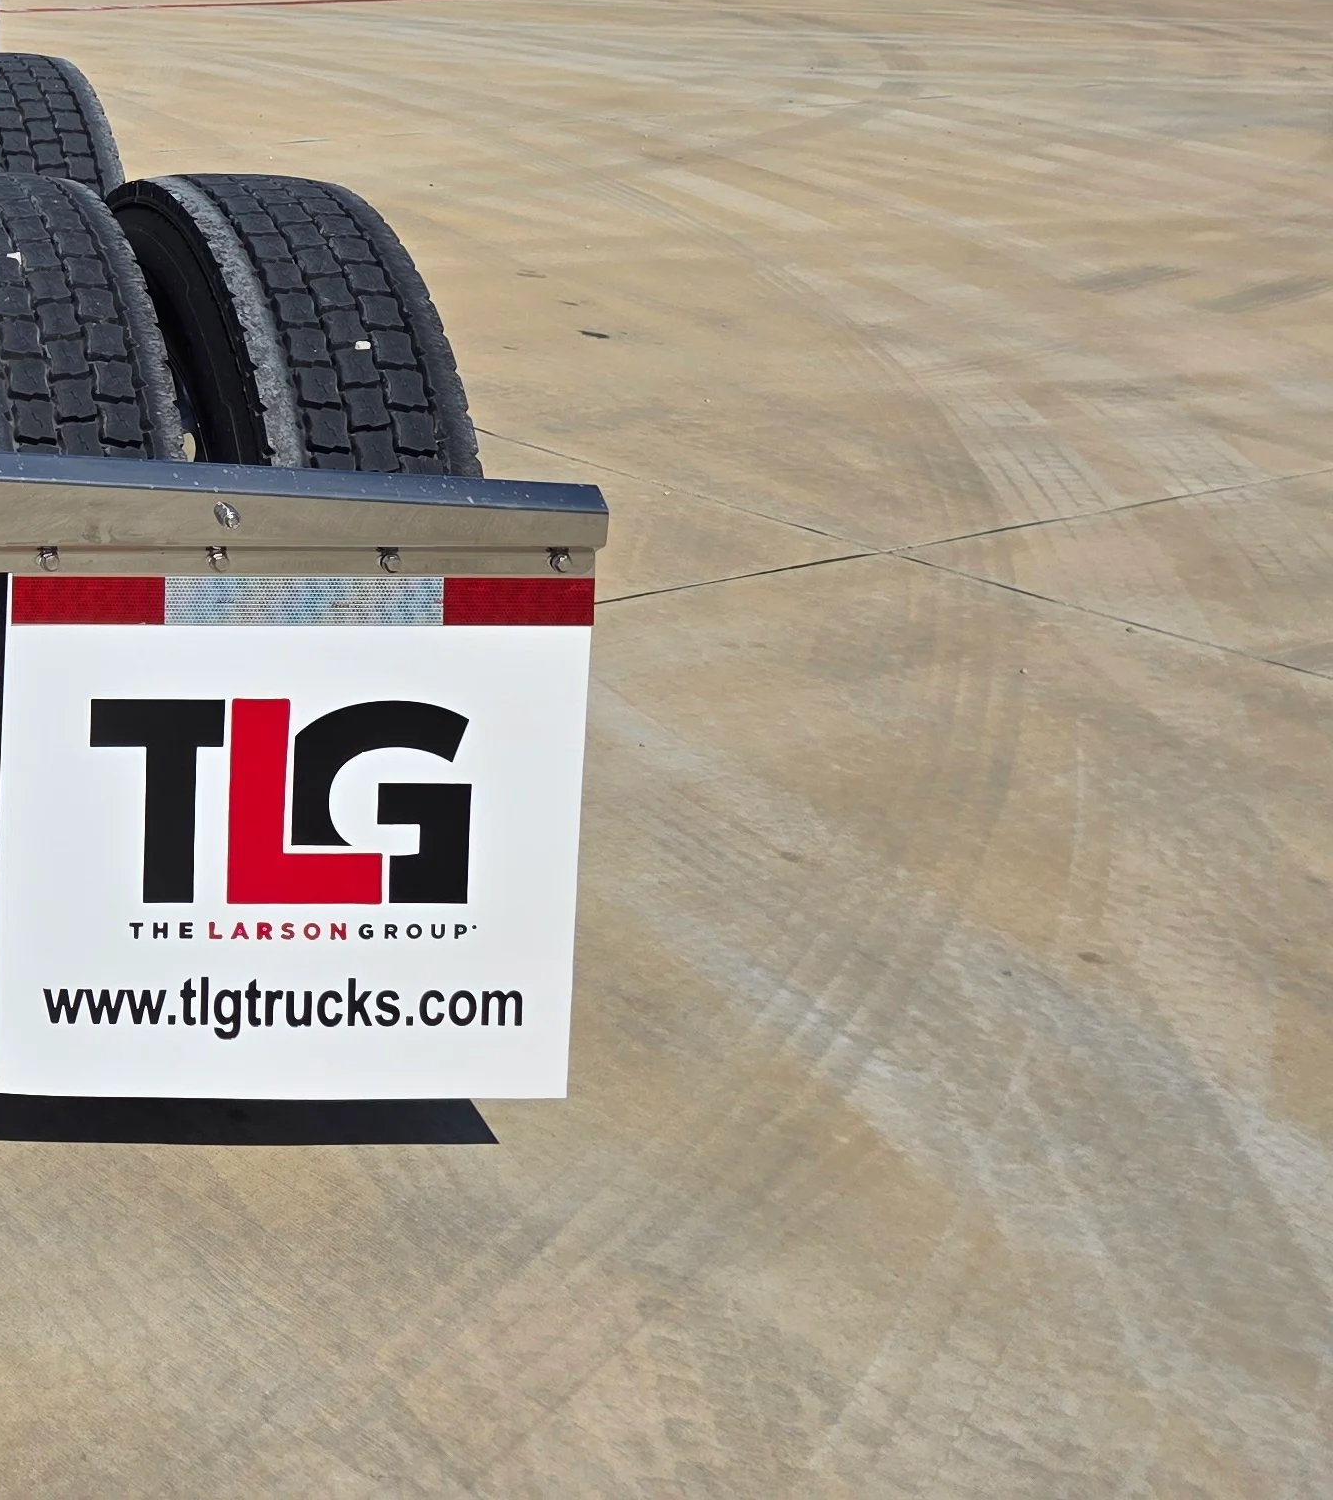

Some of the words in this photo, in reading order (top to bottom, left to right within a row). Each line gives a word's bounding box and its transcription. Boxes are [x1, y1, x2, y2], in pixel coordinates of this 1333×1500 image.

[89, 698, 473, 905] TLG
[128, 921, 194, 941] THE
[208, 922, 347, 941] LARSON
[357, 922, 468, 941] GROUP
[42, 977, 524, 1041] www.tlgtrucks.com
